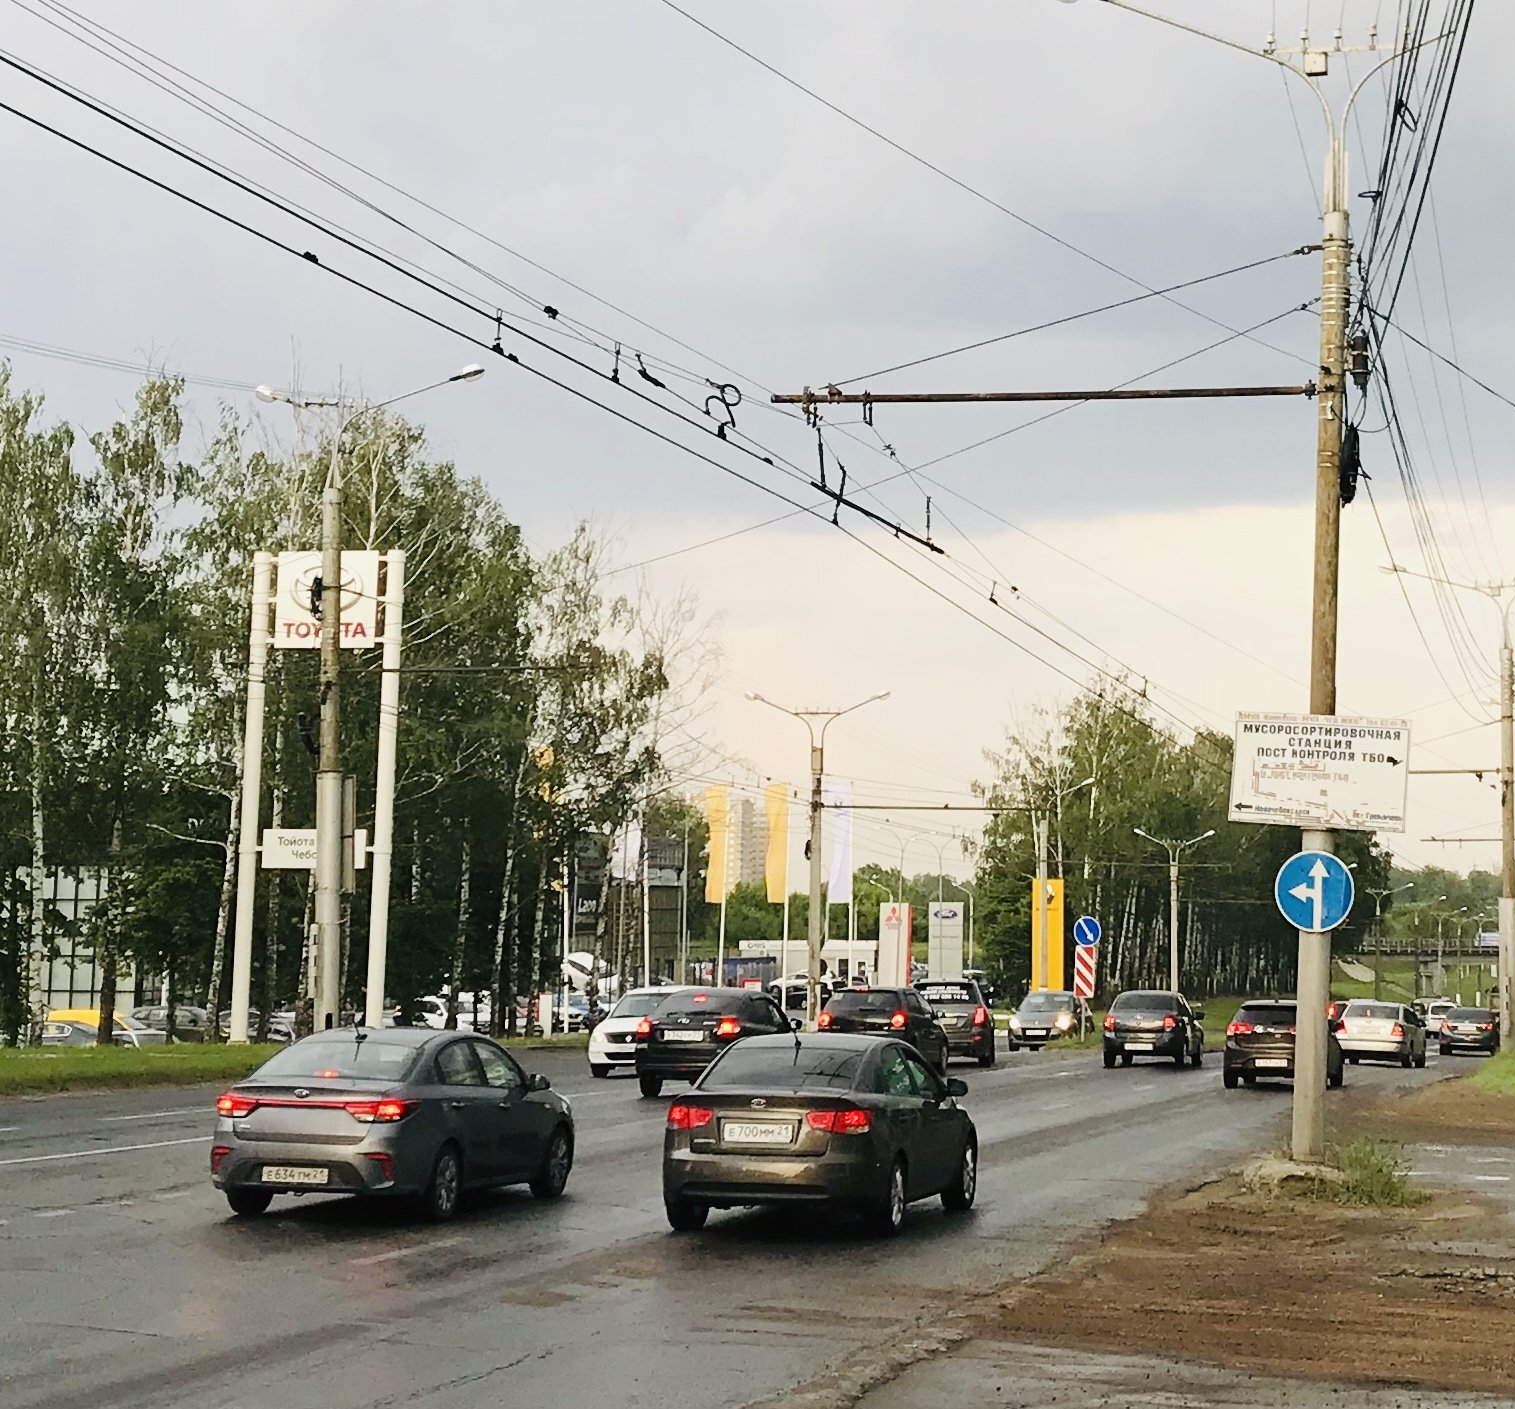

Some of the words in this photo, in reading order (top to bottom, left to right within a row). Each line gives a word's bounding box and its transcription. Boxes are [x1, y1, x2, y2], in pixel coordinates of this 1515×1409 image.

[283, 622, 367, 638] TOYTA
[1243, 723, 1401, 741] МУСОРОСОРТИРОВОЧНАЯ
[1288, 736, 1352, 750] СТАНЦИЯ
[1256, 746, 1287, 758] ПОСТ
[1291, 748, 1355, 762] КОНТРОЛЯ
[1361, 752, 1385, 763] ТБО
